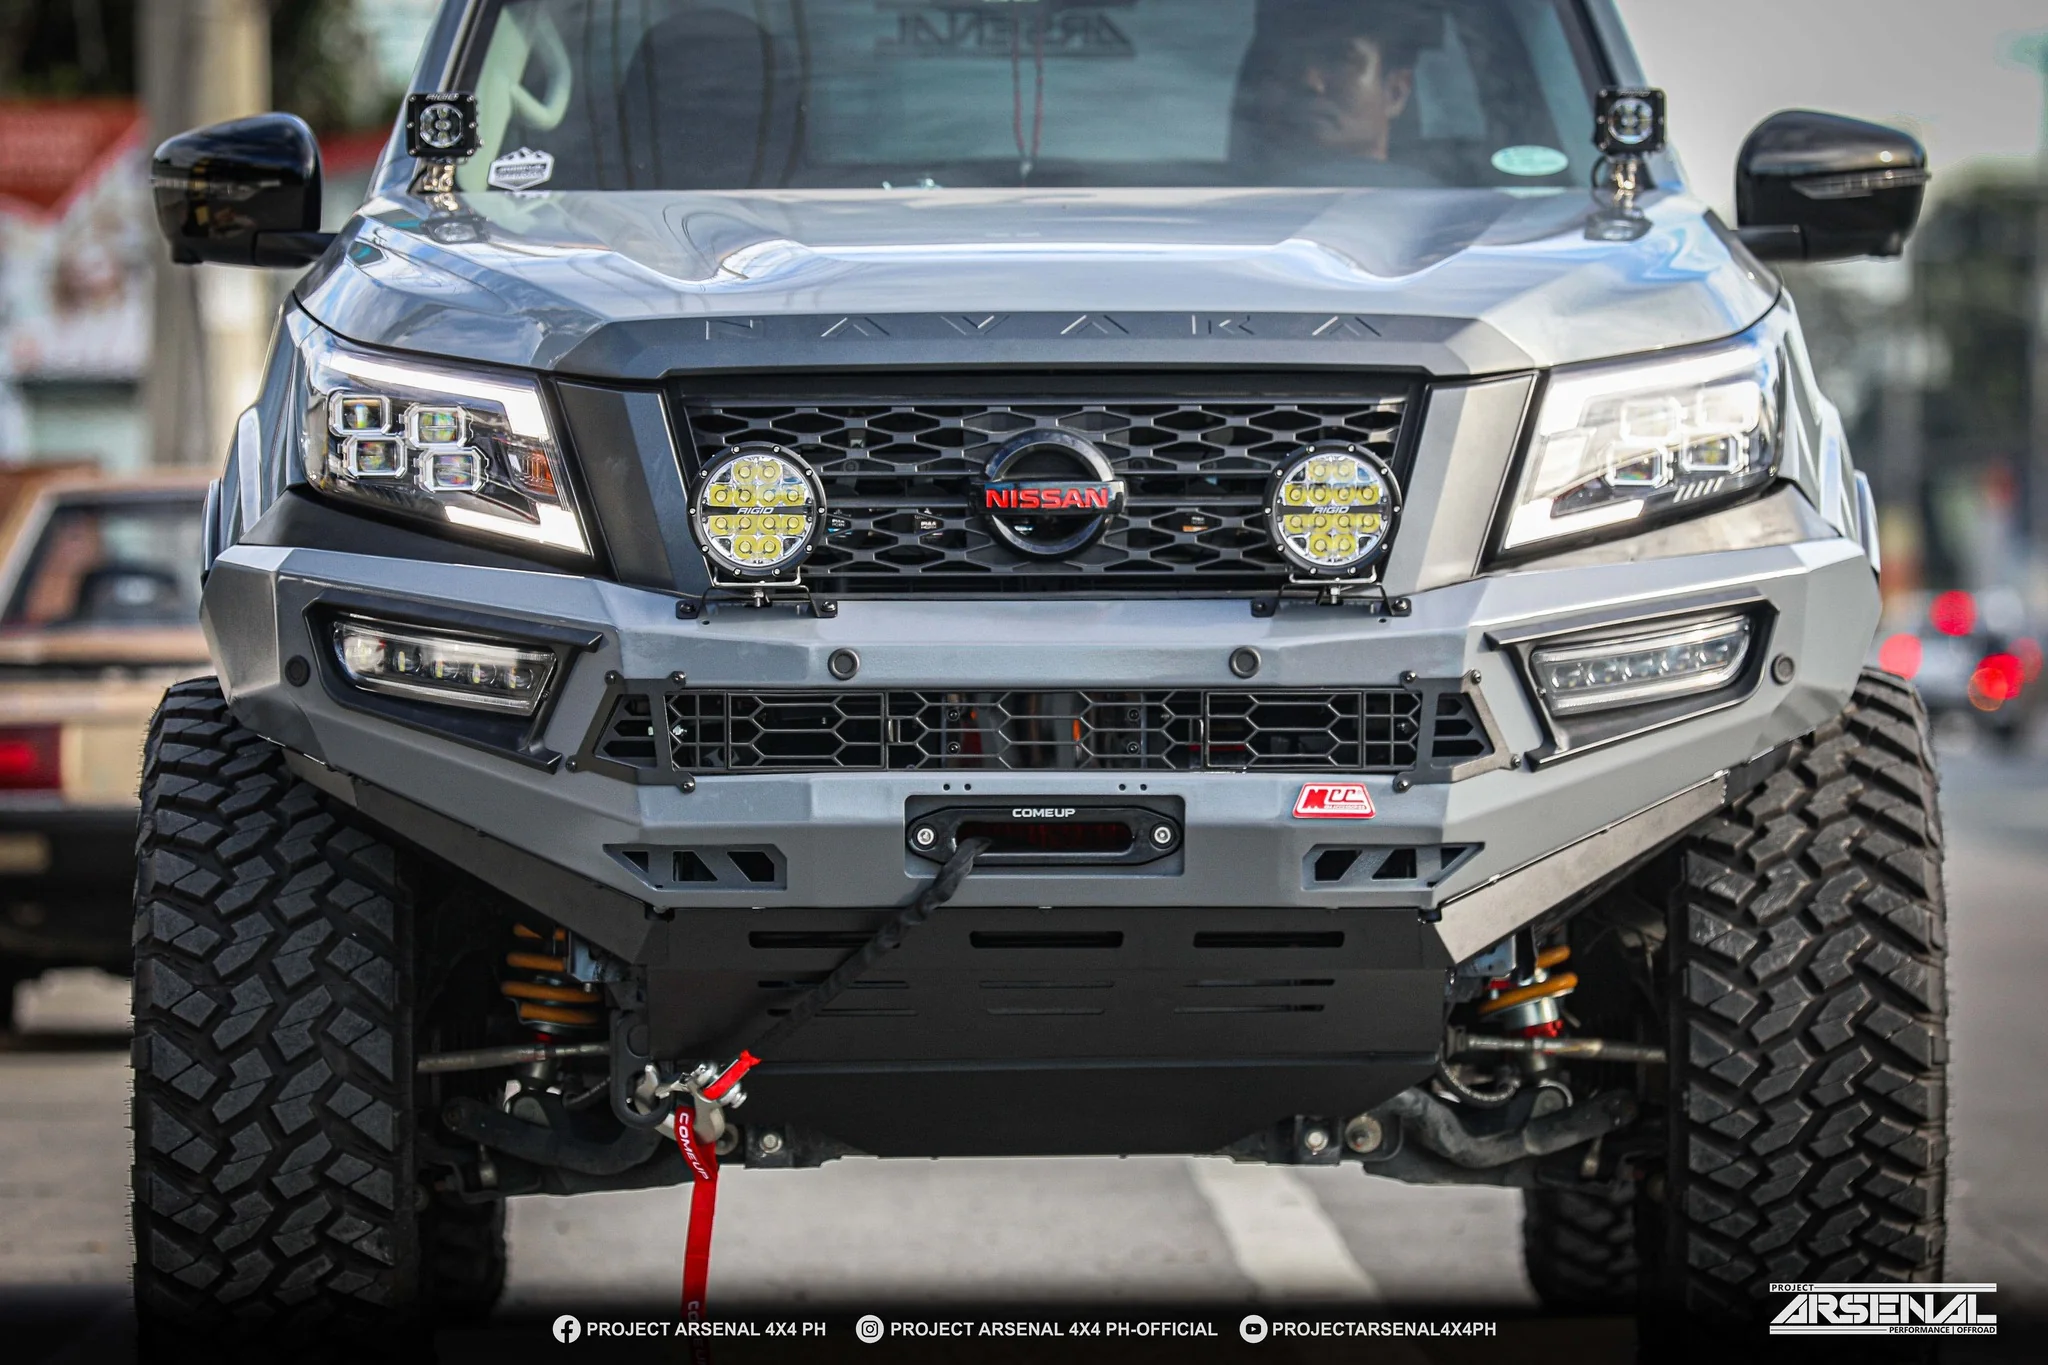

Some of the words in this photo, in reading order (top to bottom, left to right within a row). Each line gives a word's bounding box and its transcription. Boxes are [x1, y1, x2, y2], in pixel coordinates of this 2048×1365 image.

[985, 487, 1109, 509] NISSAN
[737, 506, 775, 515] RIGID
[1311, 505, 1350, 514] RIGID
[1012, 808, 1076, 818] COMEUP
[679, 1112, 709, 1180] COMEUP
